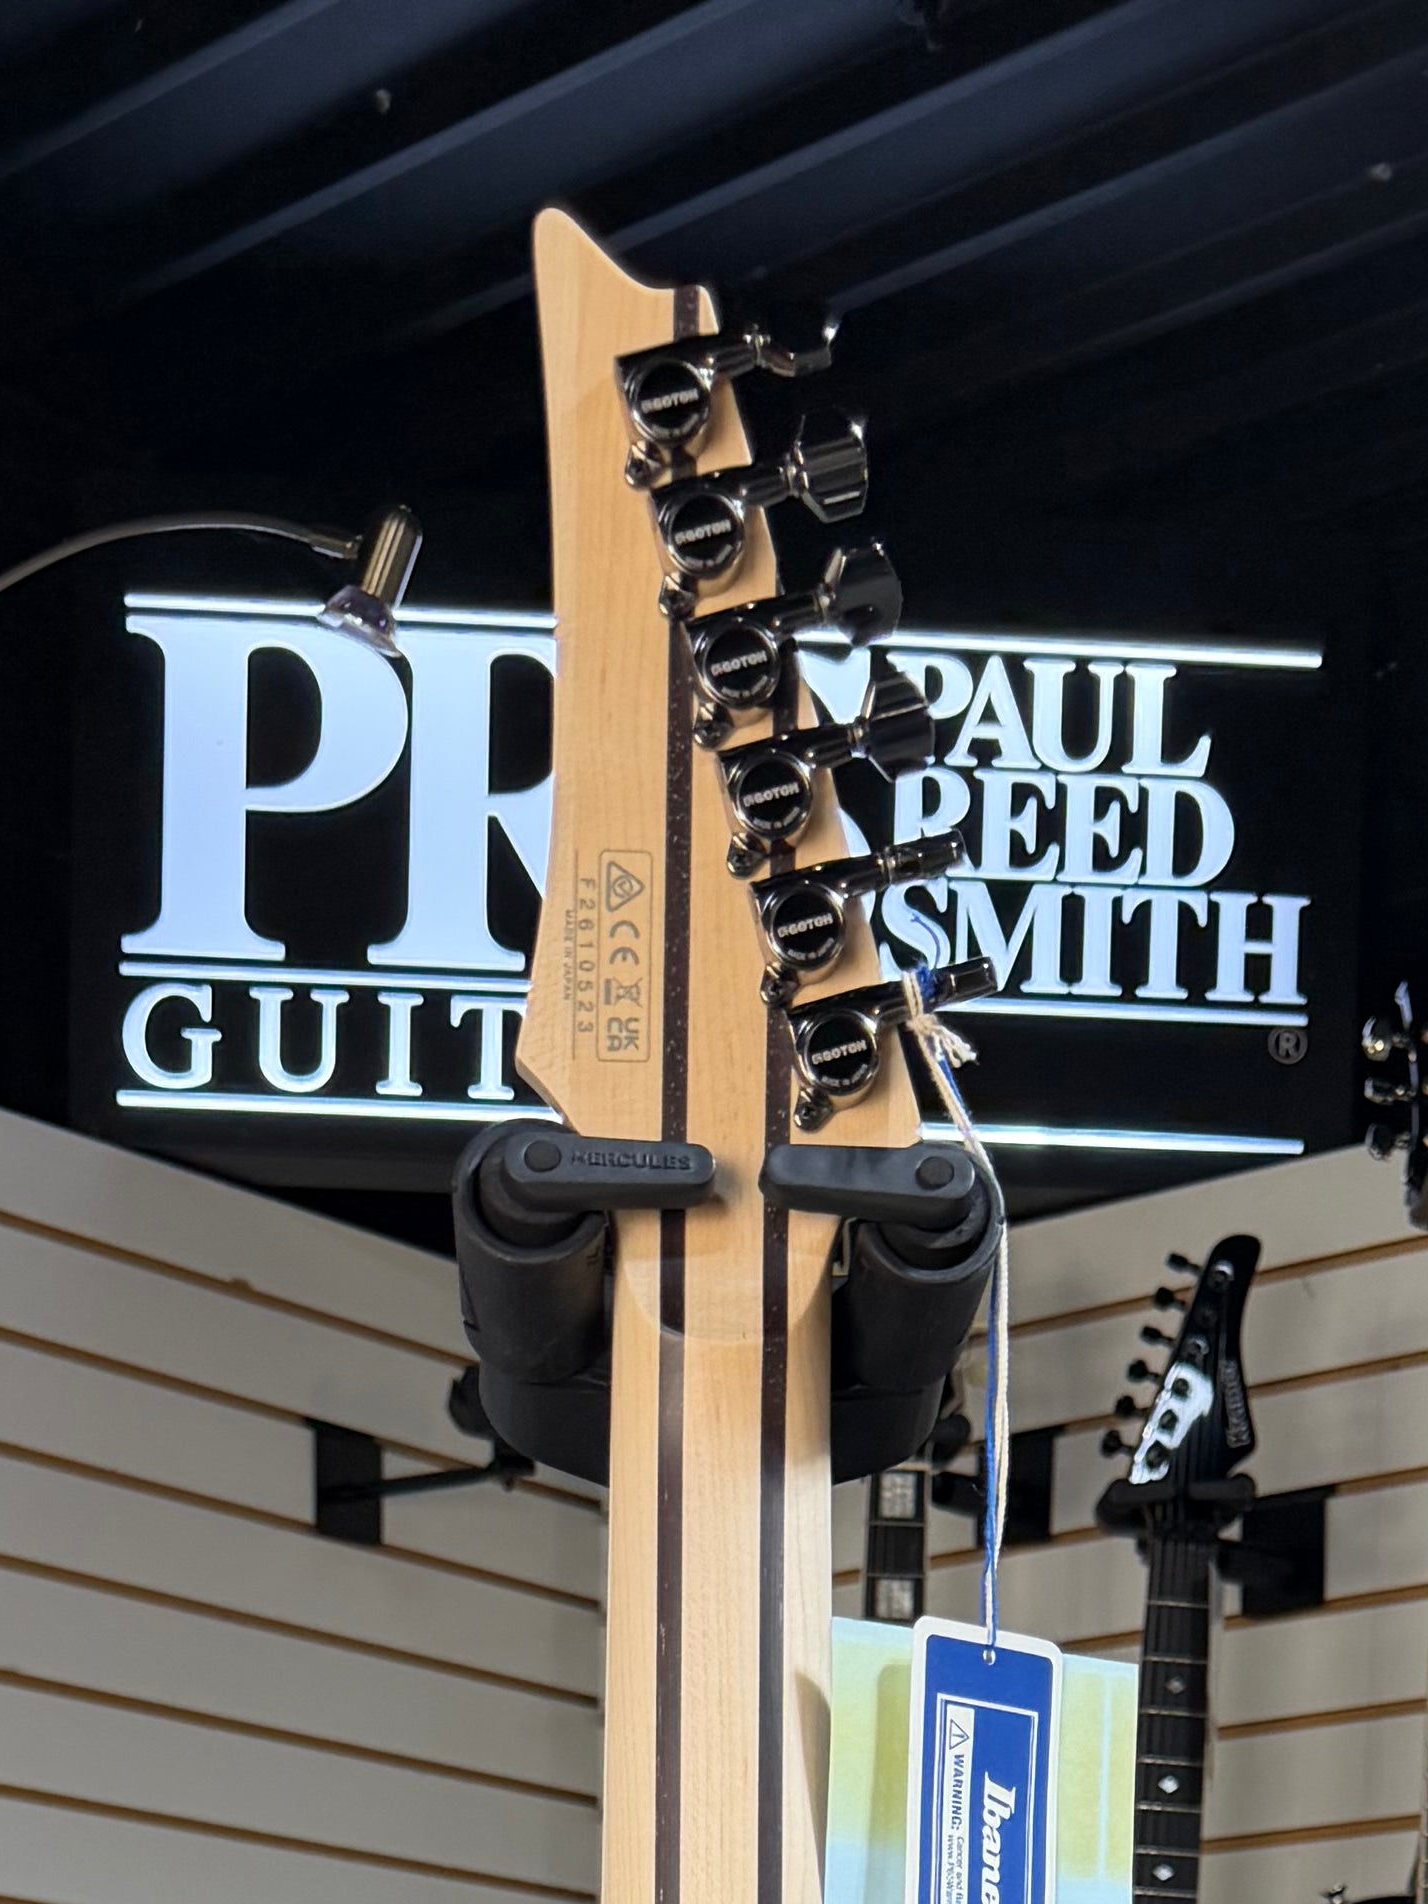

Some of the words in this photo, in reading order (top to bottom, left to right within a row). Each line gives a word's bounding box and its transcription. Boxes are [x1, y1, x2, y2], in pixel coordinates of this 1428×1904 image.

[886, 654, 1212, 778] PAUL
[893, 768, 1236, 888] REED
[576, 877, 597, 1034] F2610523
[878, 878, 1312, 1006] SMITH
[121, 983, 528, 1102] GUIT
[572, 1150, 693, 1172] HERCULES
[950, 1753, 966, 1831] WARNING:
